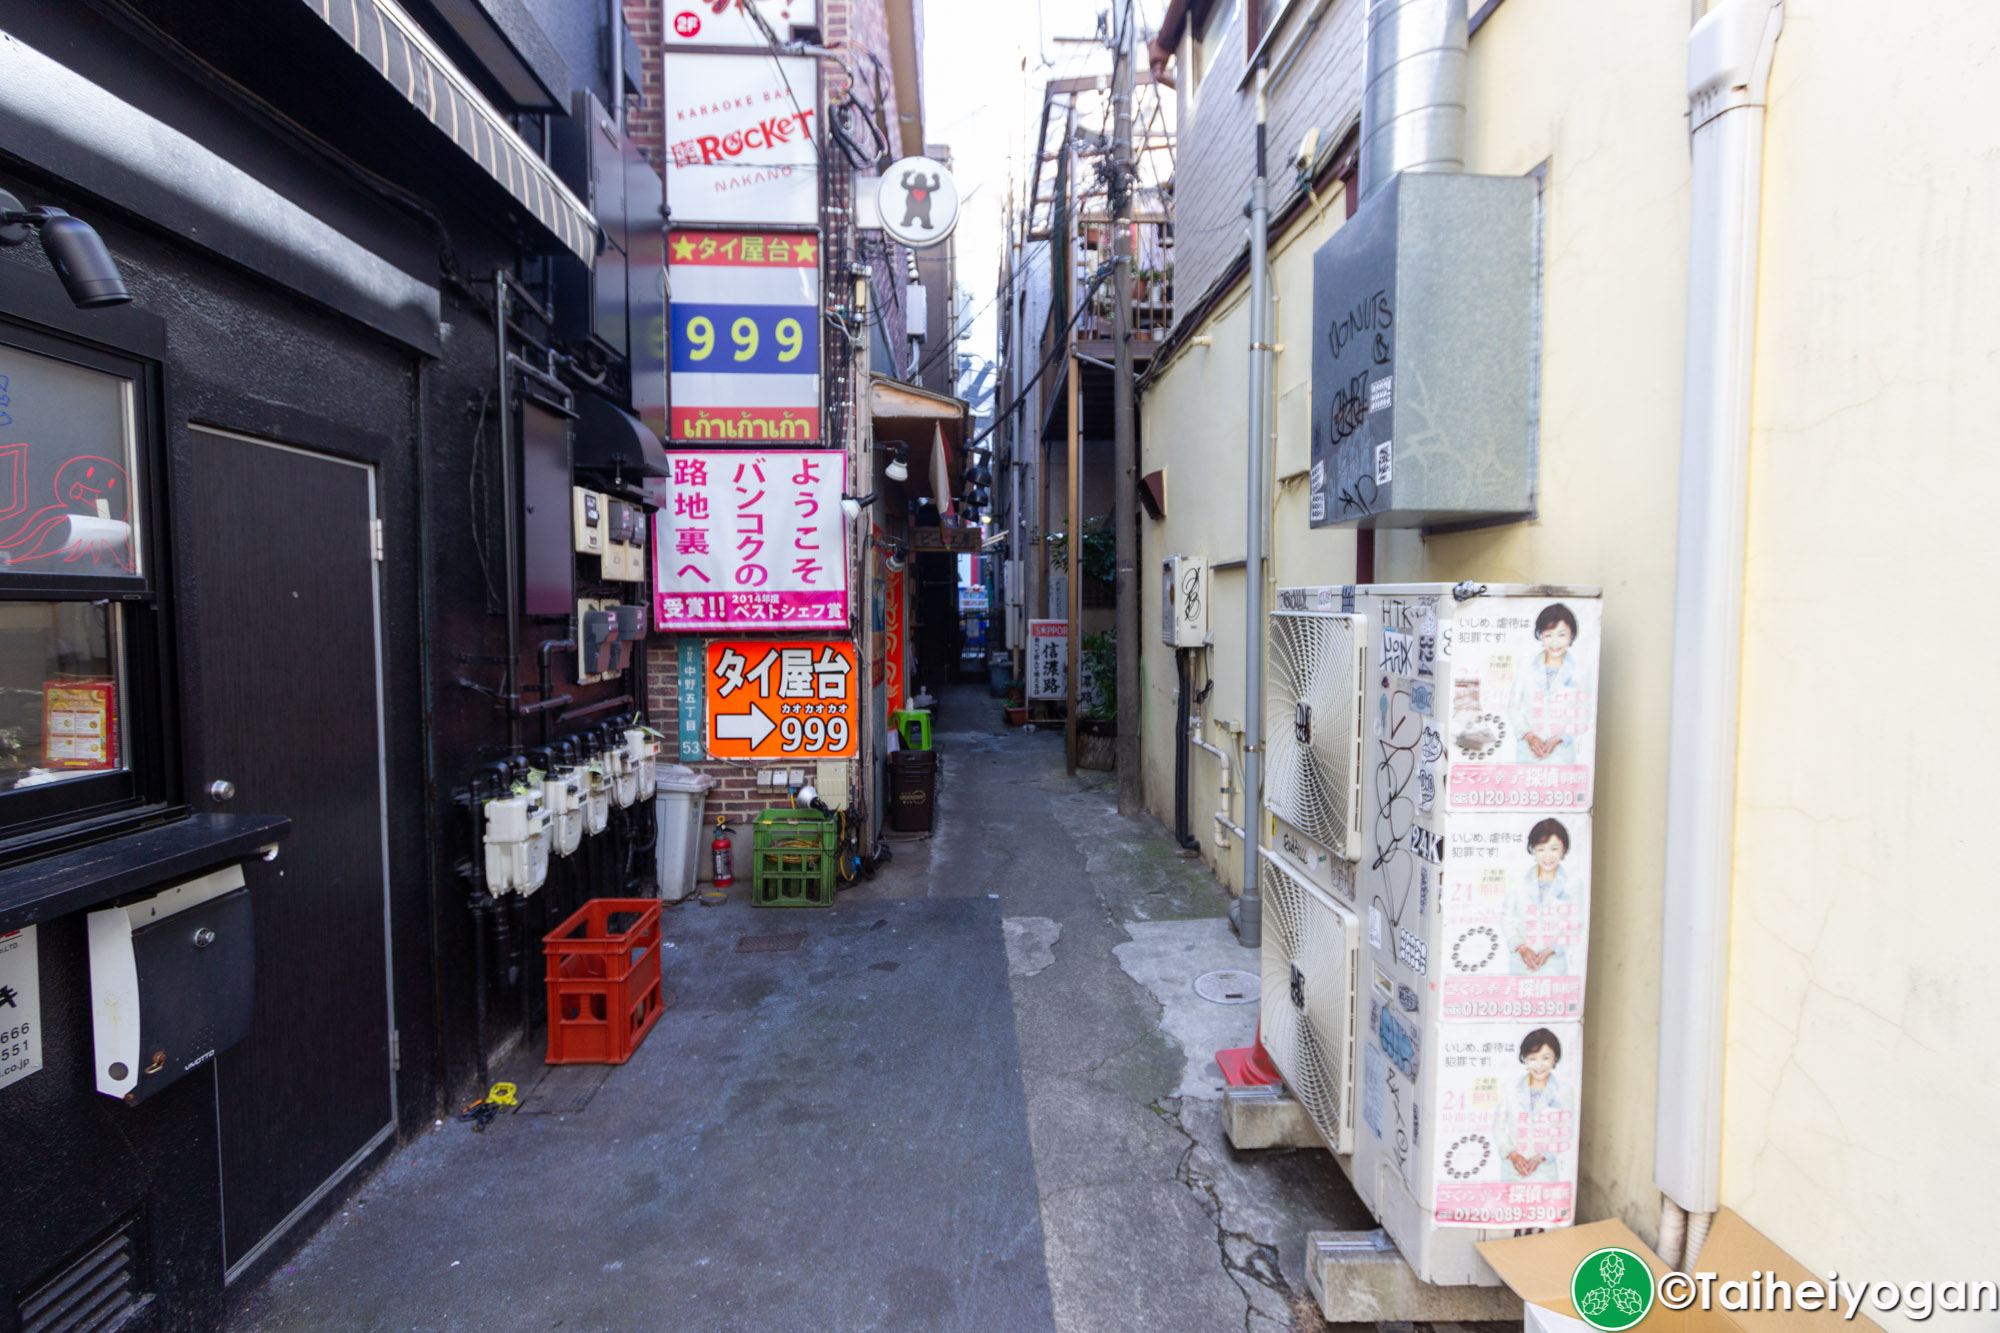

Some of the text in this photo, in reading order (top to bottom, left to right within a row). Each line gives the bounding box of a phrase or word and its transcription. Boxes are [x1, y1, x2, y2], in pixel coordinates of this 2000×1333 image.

[677, 16, 697, 33] 2F
[677, 94, 753, 121] KARAOKE
[714, 165, 793, 192] NAKANO
[698, 236, 791, 263] タイ屋台
[673, 458, 711, 584] 路地裏へ
[732, 457, 768, 588] バンコクの
[791, 458, 823, 585] ようこそ
[731, 594, 780, 604] 2014年度
[733, 602, 842, 619] ベストシェフ賞
[714, 646, 852, 699] タイ屋台
[1042, 641, 1061, 695] 信濃路
[684, 665, 697, 732] 中野五丁目
[682, 741, 700, 754] 53
[780, 716, 850, 752] 999
[1469, 790, 1573, 806] 0120-089-390
[1411, 824, 1442, 865] 24K
[1463, 1000, 1566, 1017] 0120-089-390
[1454, 1206, 1557, 1223] 0120-089-390
